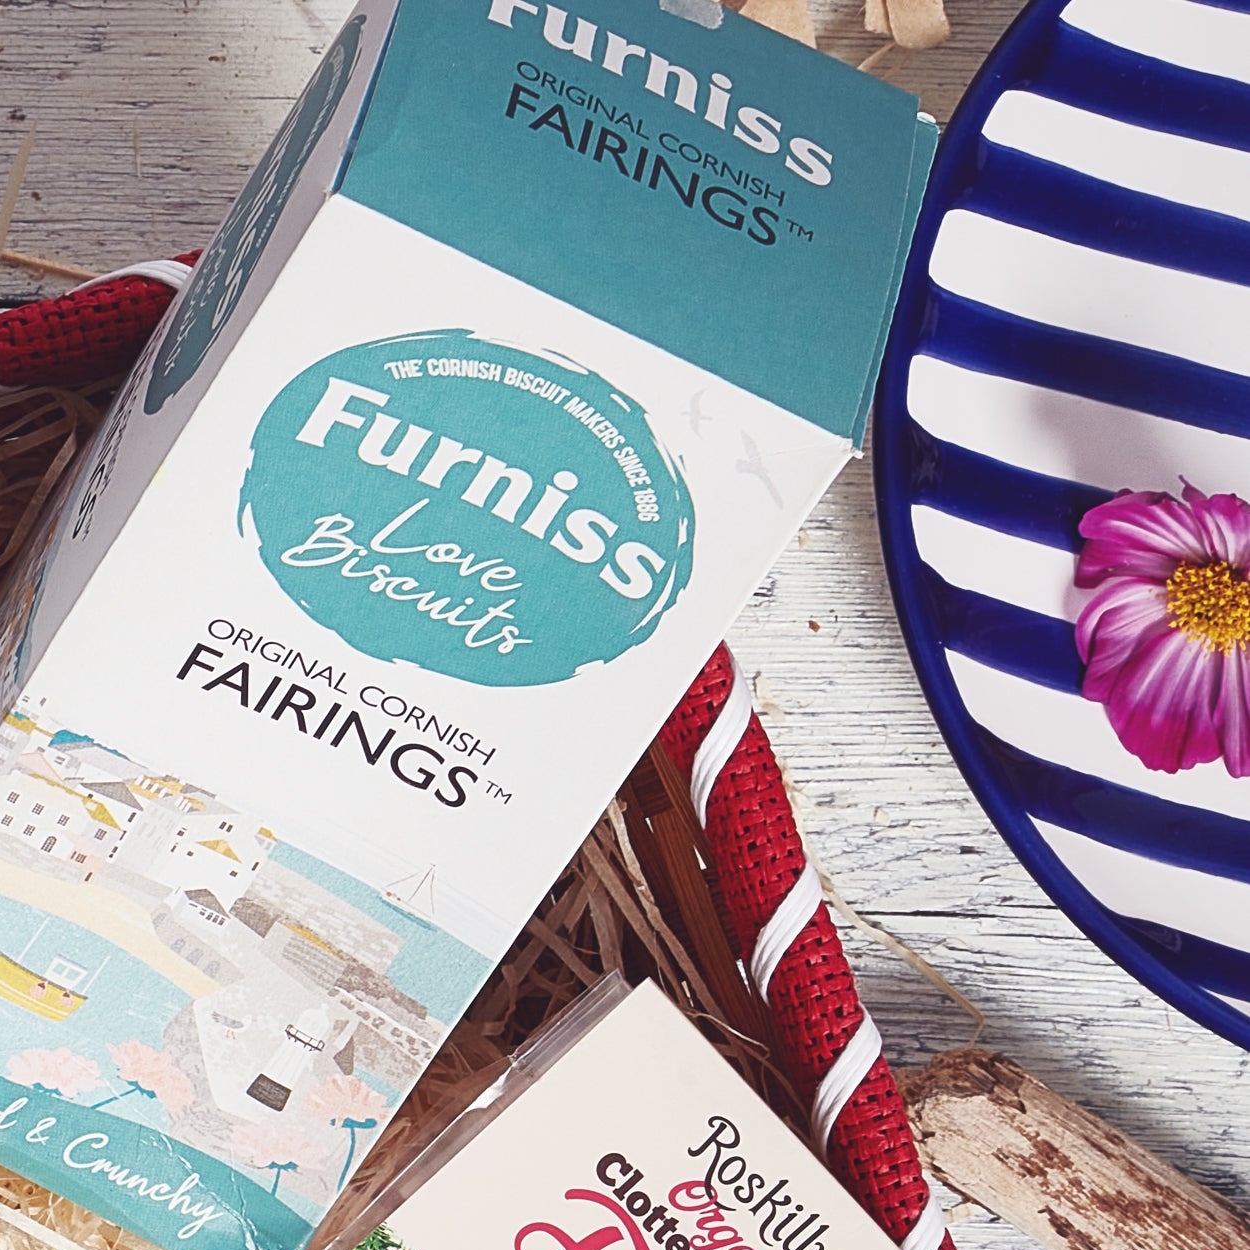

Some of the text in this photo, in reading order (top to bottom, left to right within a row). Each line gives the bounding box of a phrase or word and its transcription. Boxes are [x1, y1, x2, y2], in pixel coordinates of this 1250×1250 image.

[516, 62, 786, 207] ORIGINAL CORNISH
[295, 376, 666, 600] Furniss
[427, 358, 501, 382] CORNISH
[503, 367, 572, 406] BISCUIT
[563, 396, 625, 450] MAKERS
[613, 446, 651, 488] SINCE
[633, 488, 660, 522] 1886
[281, 512, 533, 653] Biscuits
[371, 498, 522, 591] Love
[208, 619, 497, 766] ORIGINAL CORNISH
[26, 1117, 57, 1146] &
[62, 1132, 223, 1239] Crunchy
